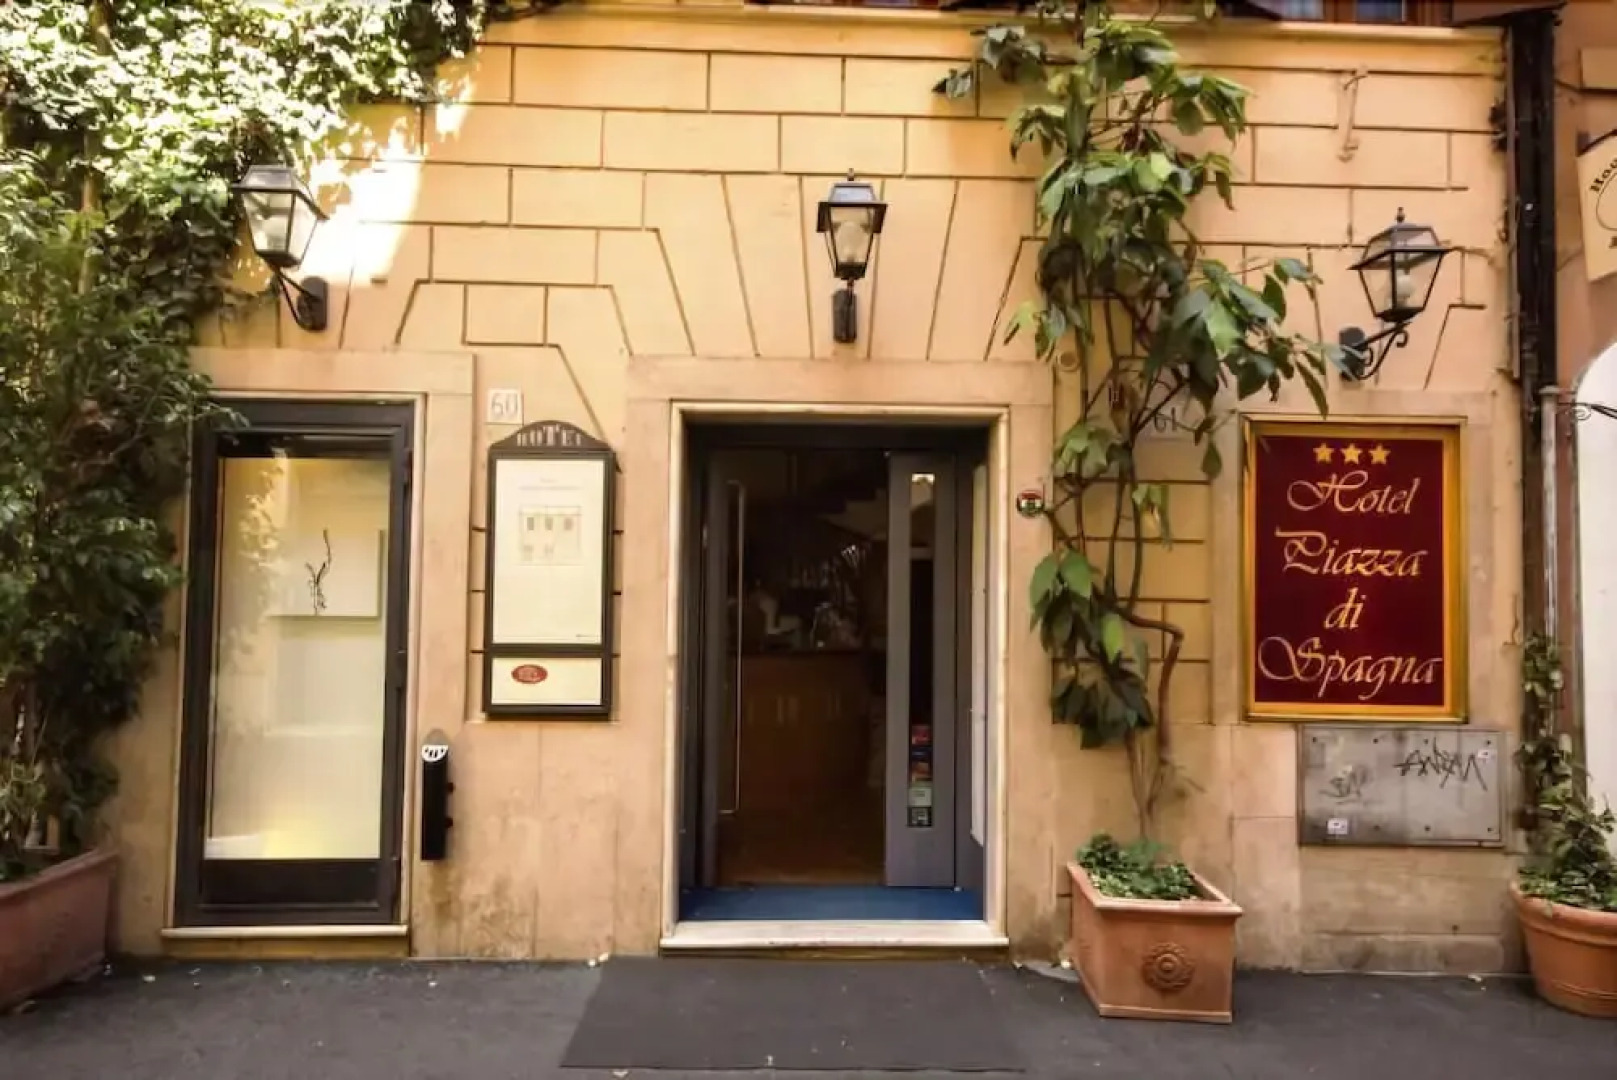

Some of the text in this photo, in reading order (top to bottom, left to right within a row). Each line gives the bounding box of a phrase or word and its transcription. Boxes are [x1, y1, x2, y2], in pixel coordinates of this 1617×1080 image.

[491, 392, 519, 417] 60
[1287, 470, 1421, 514] Hotel
[1275, 526, 1428, 577] Piazza
[1323, 586, 1367, 630] di
[1258, 636, 1443, 701] Spagna
